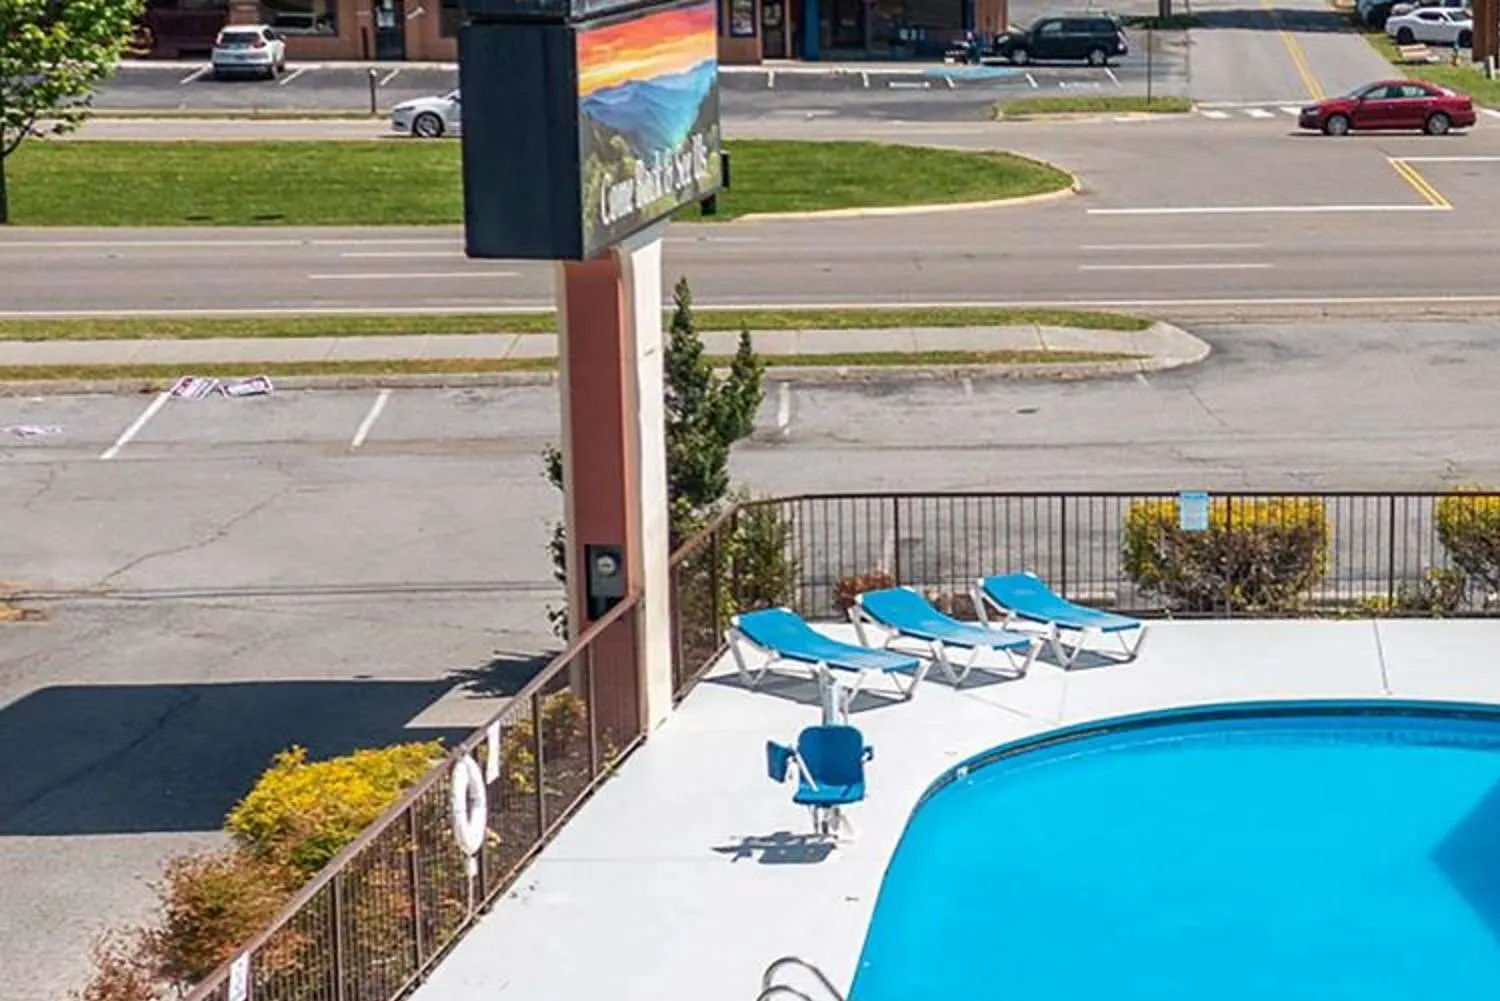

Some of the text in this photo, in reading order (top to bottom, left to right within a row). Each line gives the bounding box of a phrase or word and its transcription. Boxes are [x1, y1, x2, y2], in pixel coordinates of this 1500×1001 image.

[601, 172, 633, 225] Come
[635, 150, 662, 208] Back
[663, 147, 674, 194] to
[674, 144, 692, 190] See
